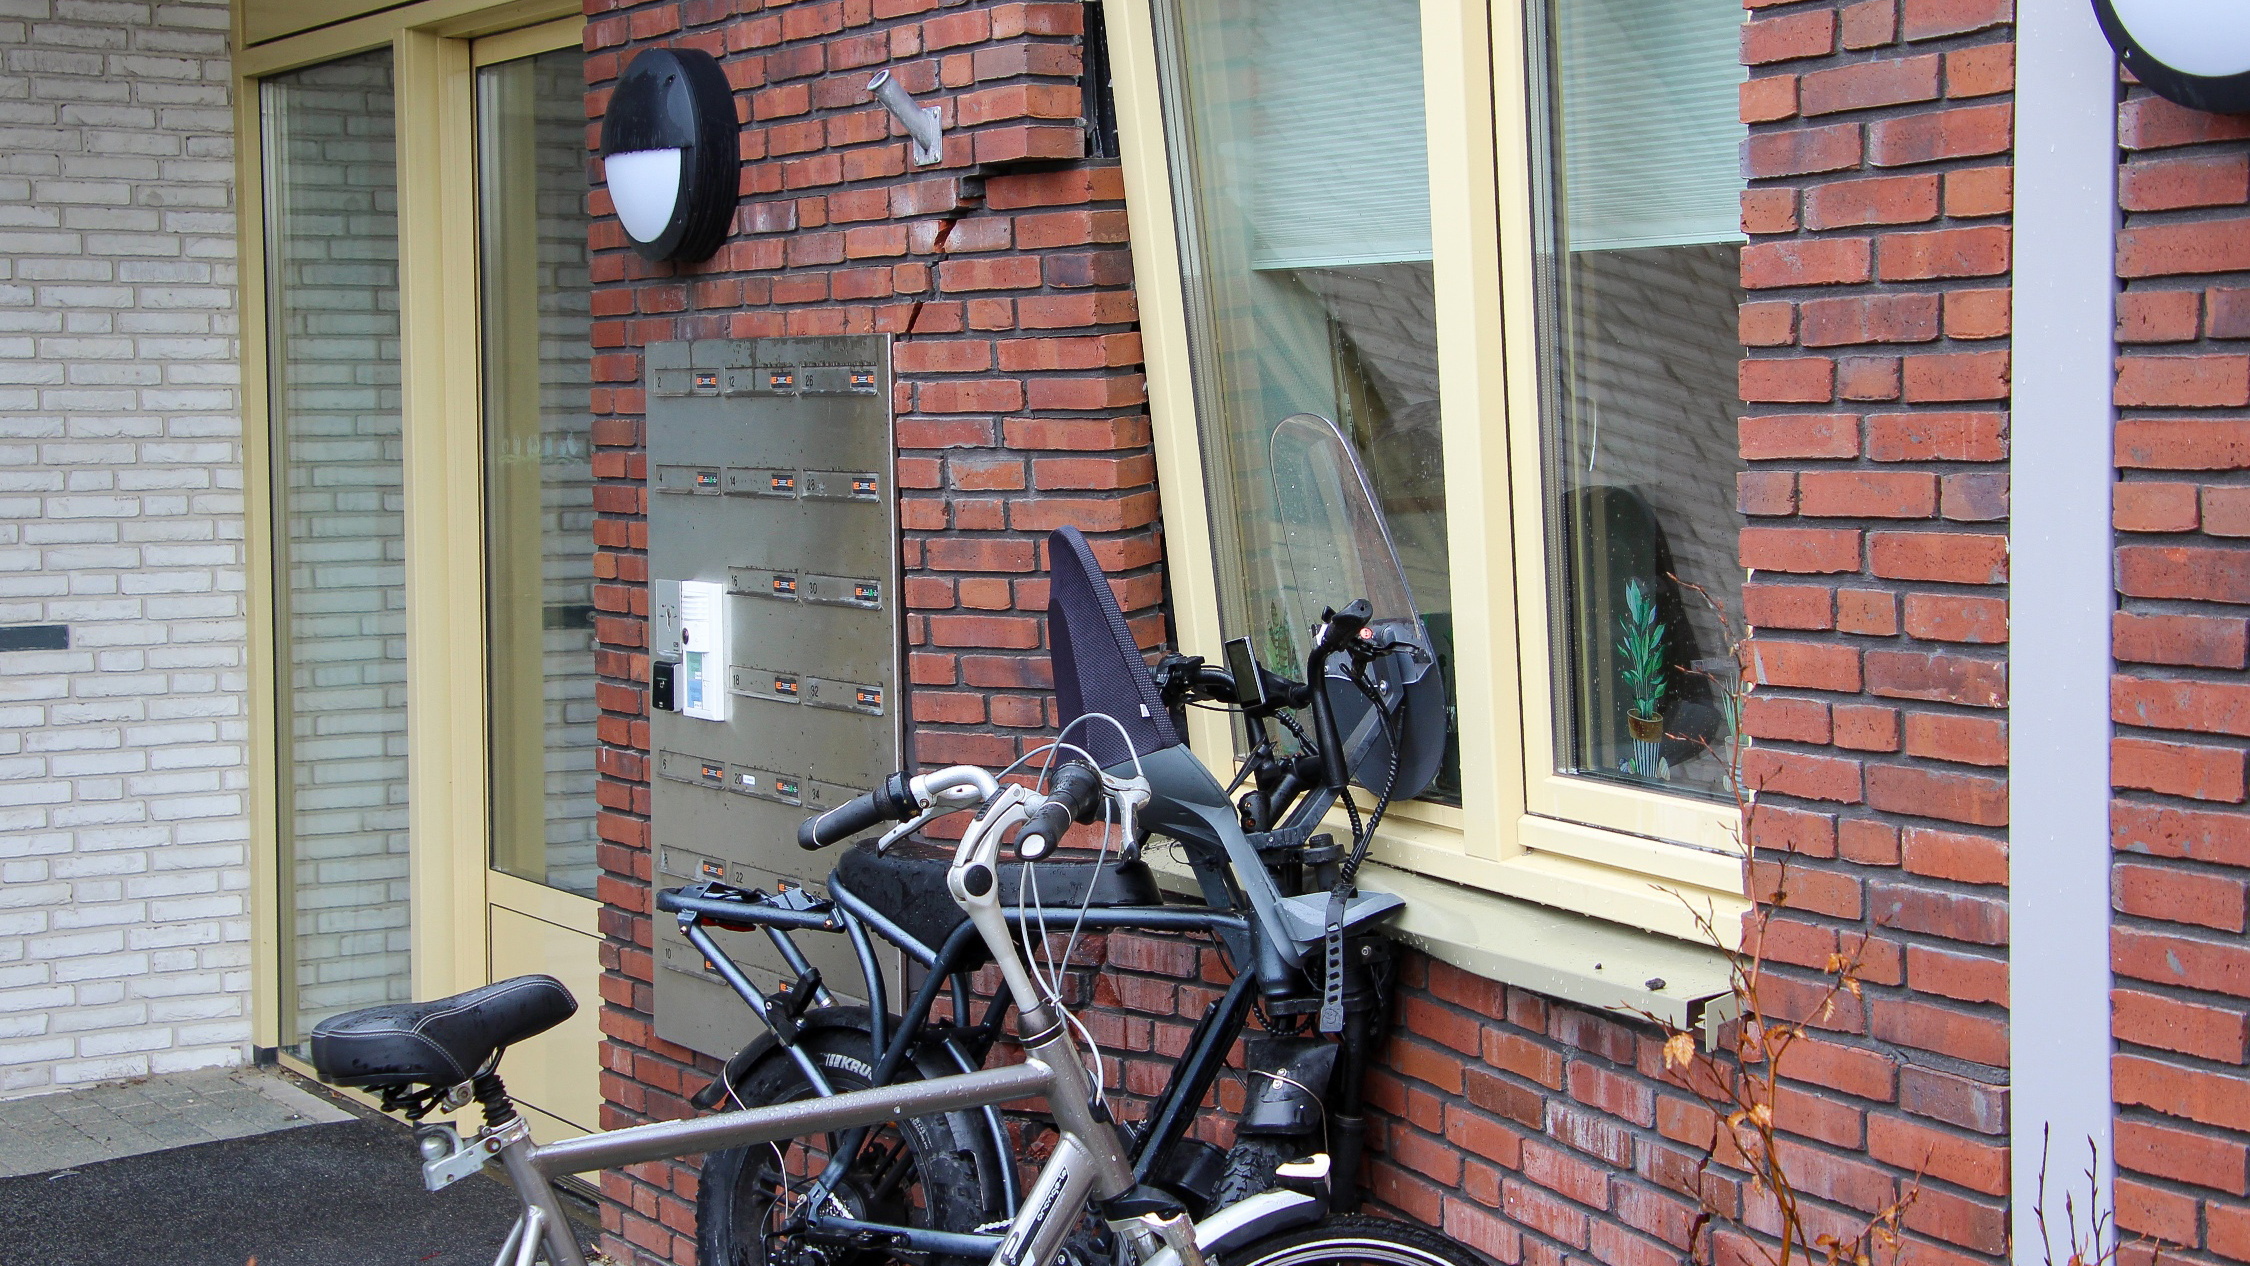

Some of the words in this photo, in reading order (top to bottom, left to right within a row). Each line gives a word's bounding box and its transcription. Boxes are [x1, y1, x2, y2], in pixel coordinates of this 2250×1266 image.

[657, 377, 662, 388] 2
[728, 376, 735, 387] 12
[805, 375, 814, 387] 26
[658, 473, 663, 483] 4
[729, 476, 736, 486] 14
[731, 575, 738, 586] 16
[808, 582, 818, 594] 30
[733, 674, 740, 686] 18
[810, 685, 819, 697] 32
[811, 788, 820, 800] 34
[735, 871, 744, 884] 22
[665, 948, 672, 960] 10
[839, 1055, 873, 1080] KRU
